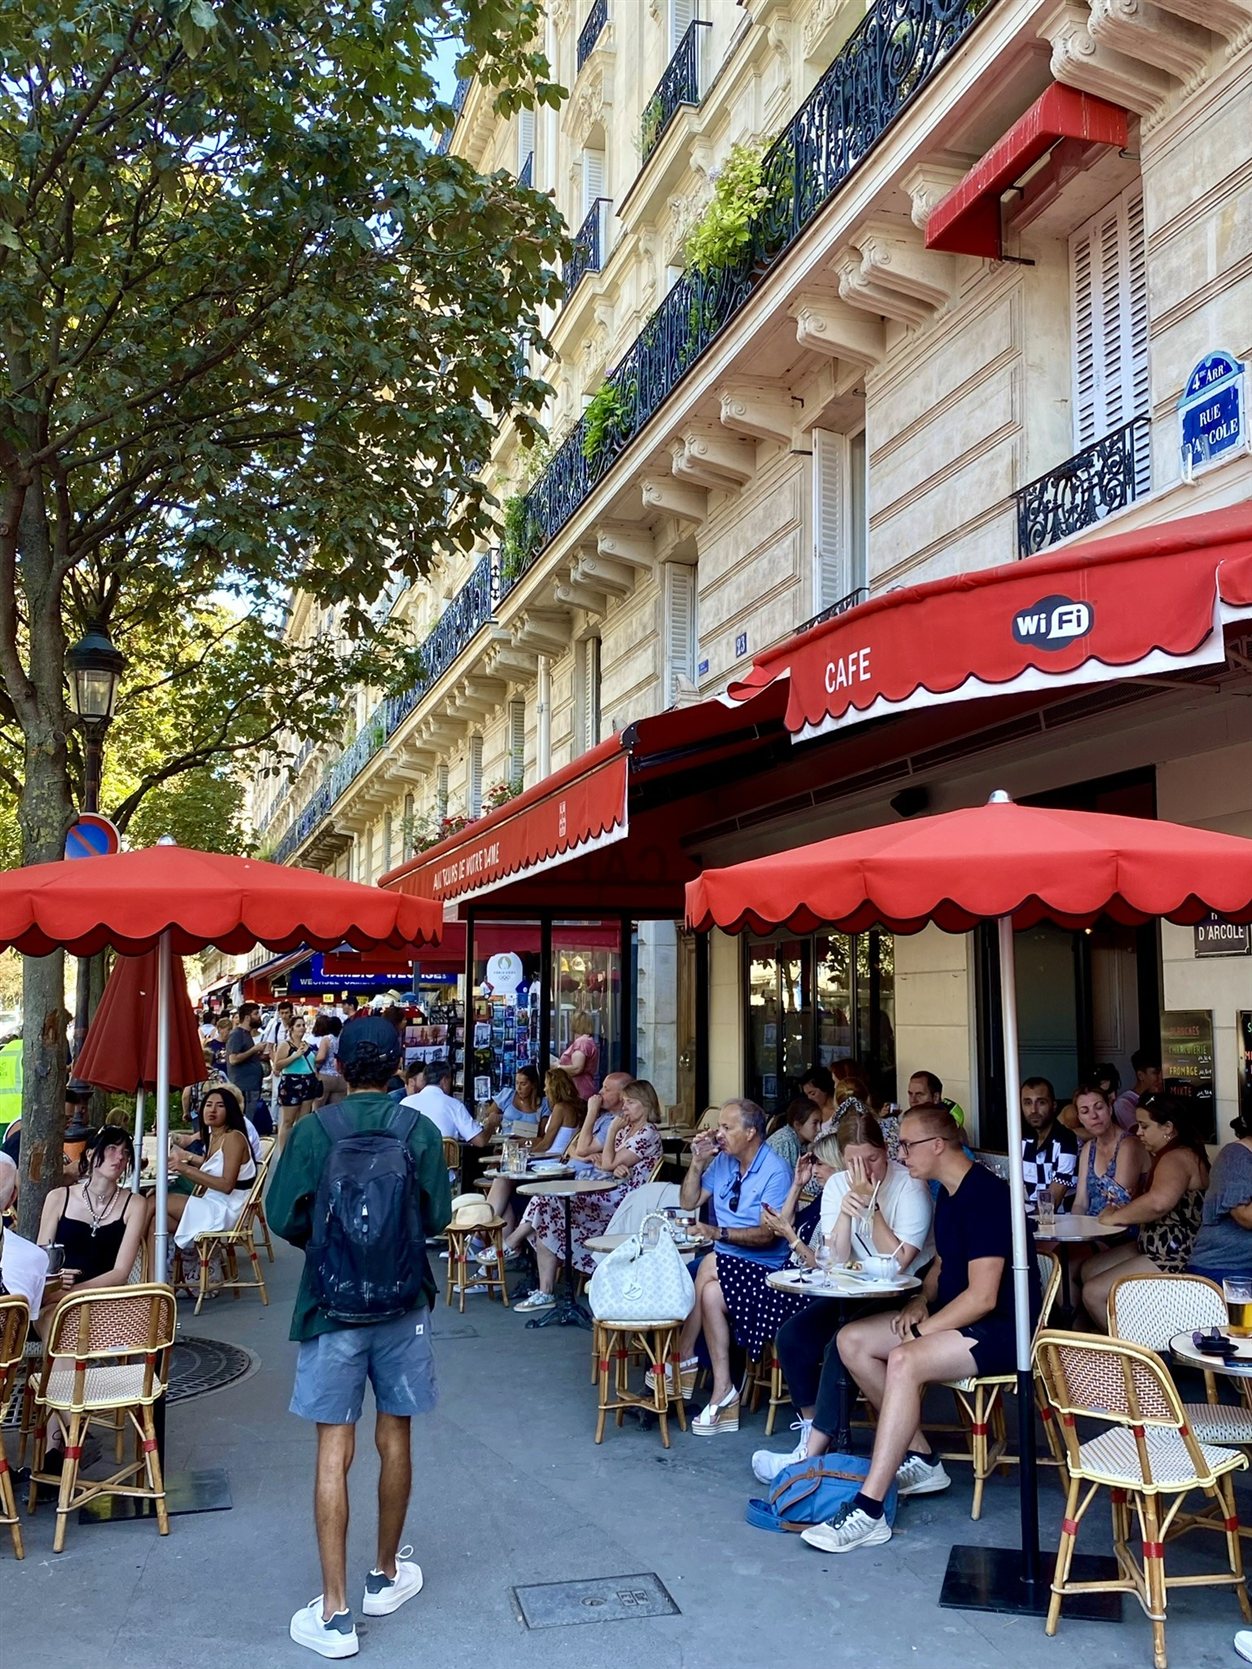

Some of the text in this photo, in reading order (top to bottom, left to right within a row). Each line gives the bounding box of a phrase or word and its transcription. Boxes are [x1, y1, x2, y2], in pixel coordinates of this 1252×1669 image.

[1199, 404, 1221, 428] RUE
[1184, 418, 1238, 455] D'ACOLE
[824, 647, 871, 693] CAFE
[458, 858, 466, 880] DE
[1198, 924, 1244, 941] D'ARCOLE
[1169, 1066, 1198, 1076] FROMAGE
